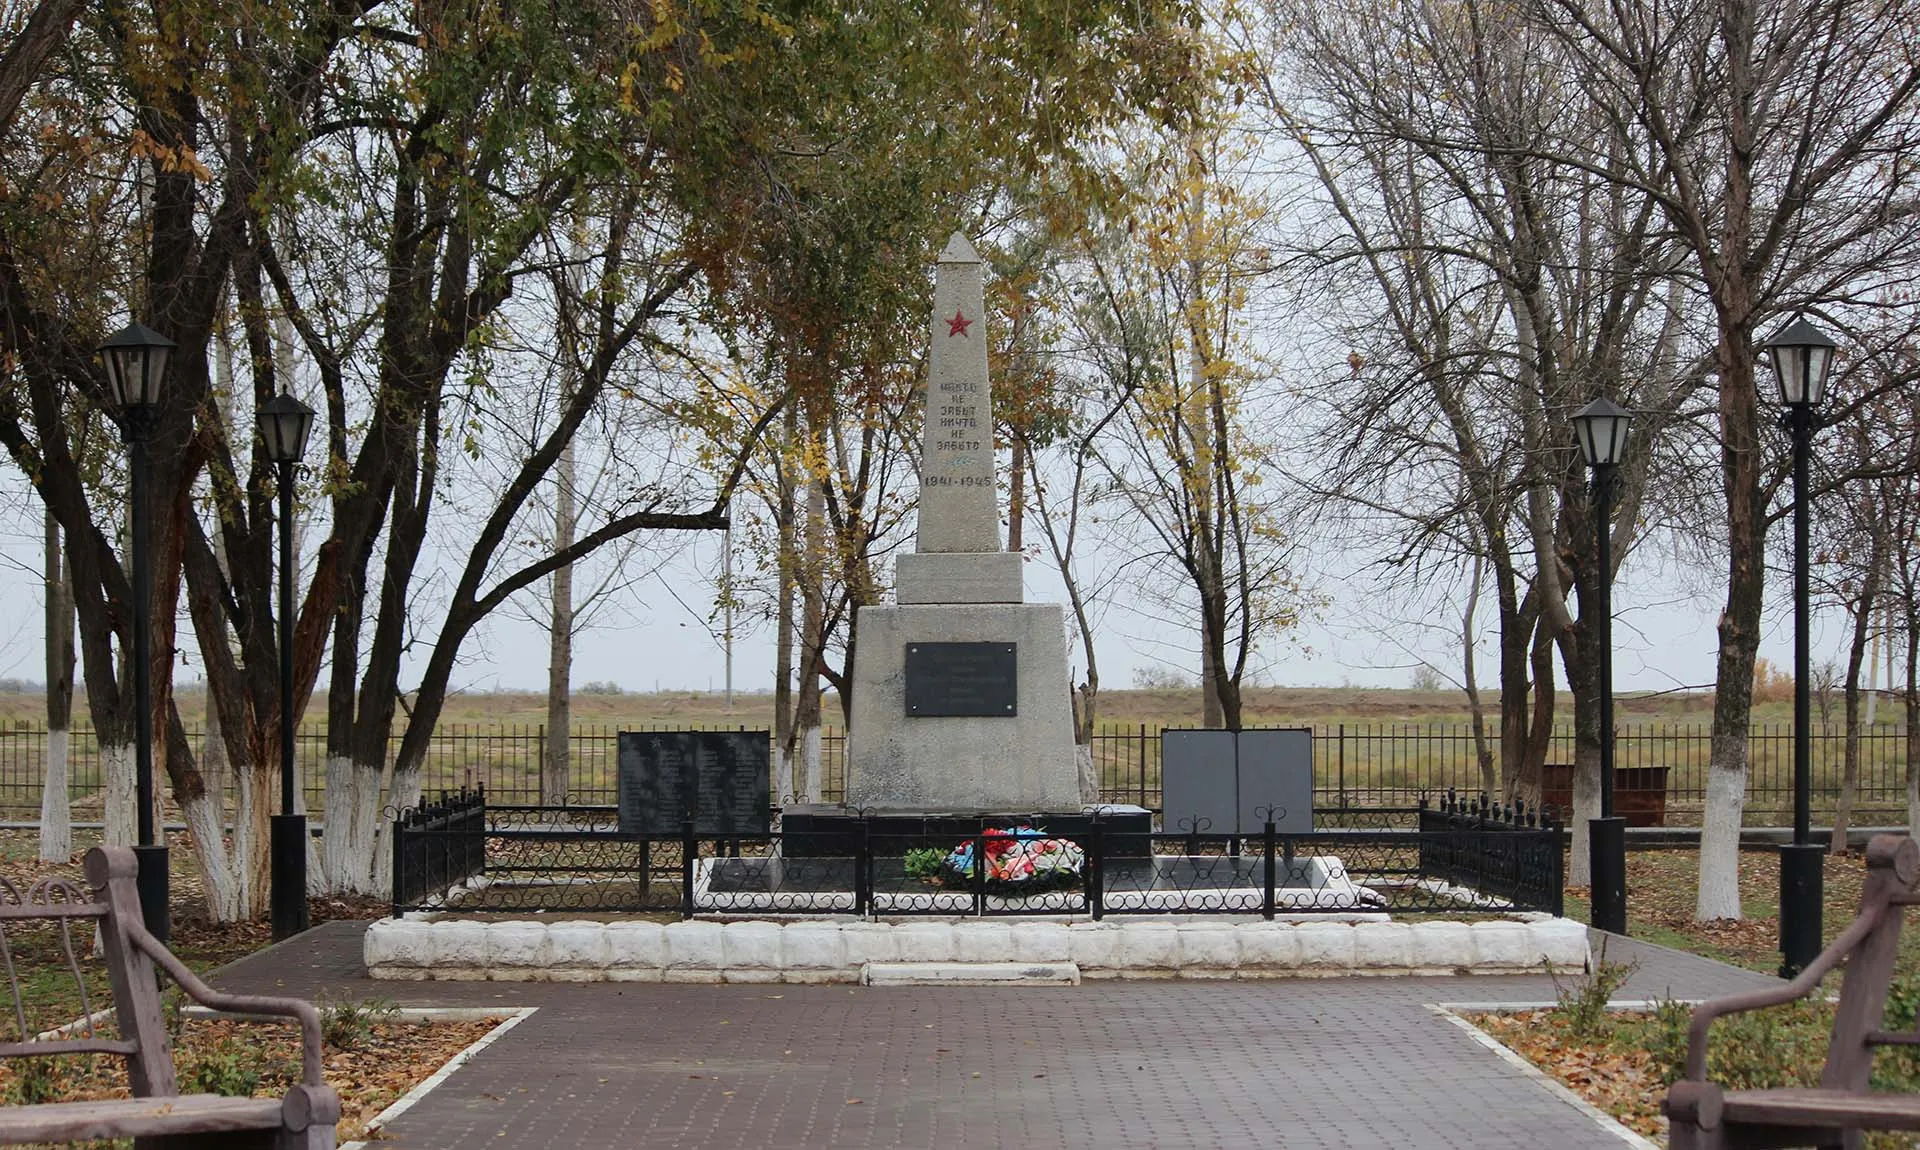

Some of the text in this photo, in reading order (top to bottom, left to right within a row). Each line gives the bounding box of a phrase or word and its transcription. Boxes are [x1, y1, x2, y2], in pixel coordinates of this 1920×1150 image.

[951, 394, 965, 404] НЕ
[940, 406, 976, 416] ЗАБЫТ
[940, 417, 977, 428] НИЧТО
[951, 429, 965, 439] НЕ
[936, 440, 980, 451] ЗАБЫТО
